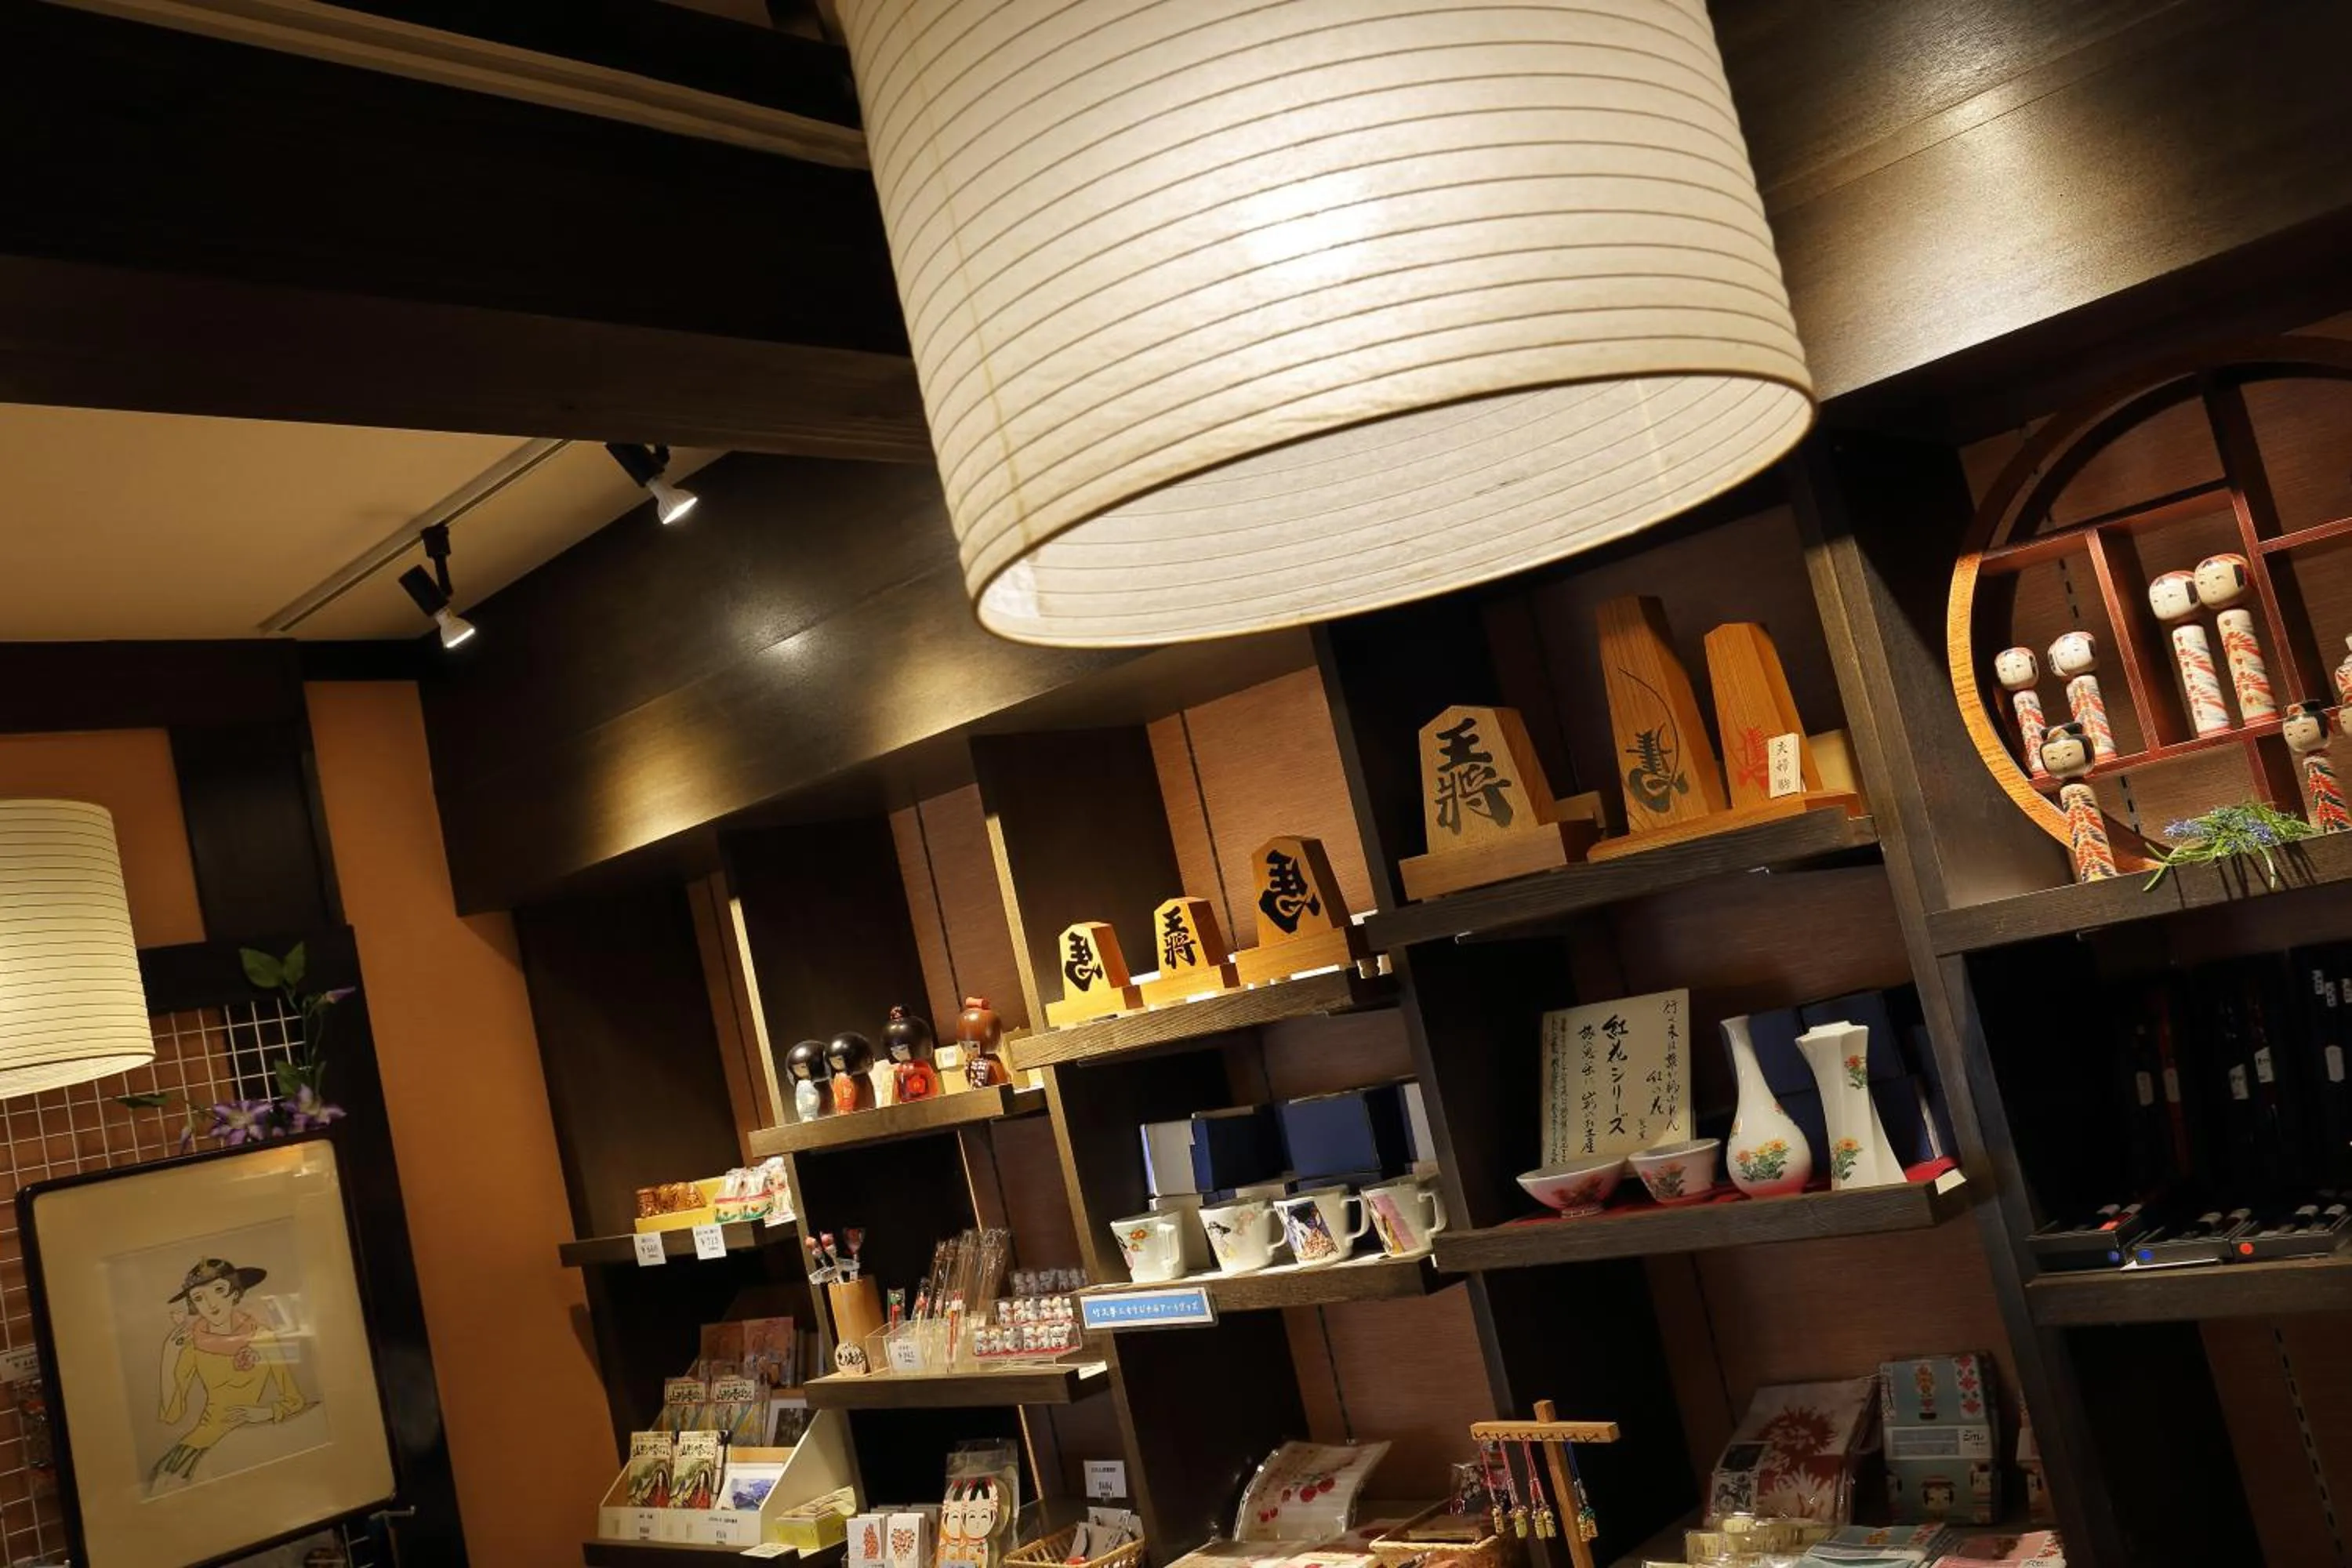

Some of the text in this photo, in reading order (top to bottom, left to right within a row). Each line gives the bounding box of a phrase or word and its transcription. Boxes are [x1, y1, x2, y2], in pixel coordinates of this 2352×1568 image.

[1602, 1014, 1628, 1134] 紅花シリーズ
